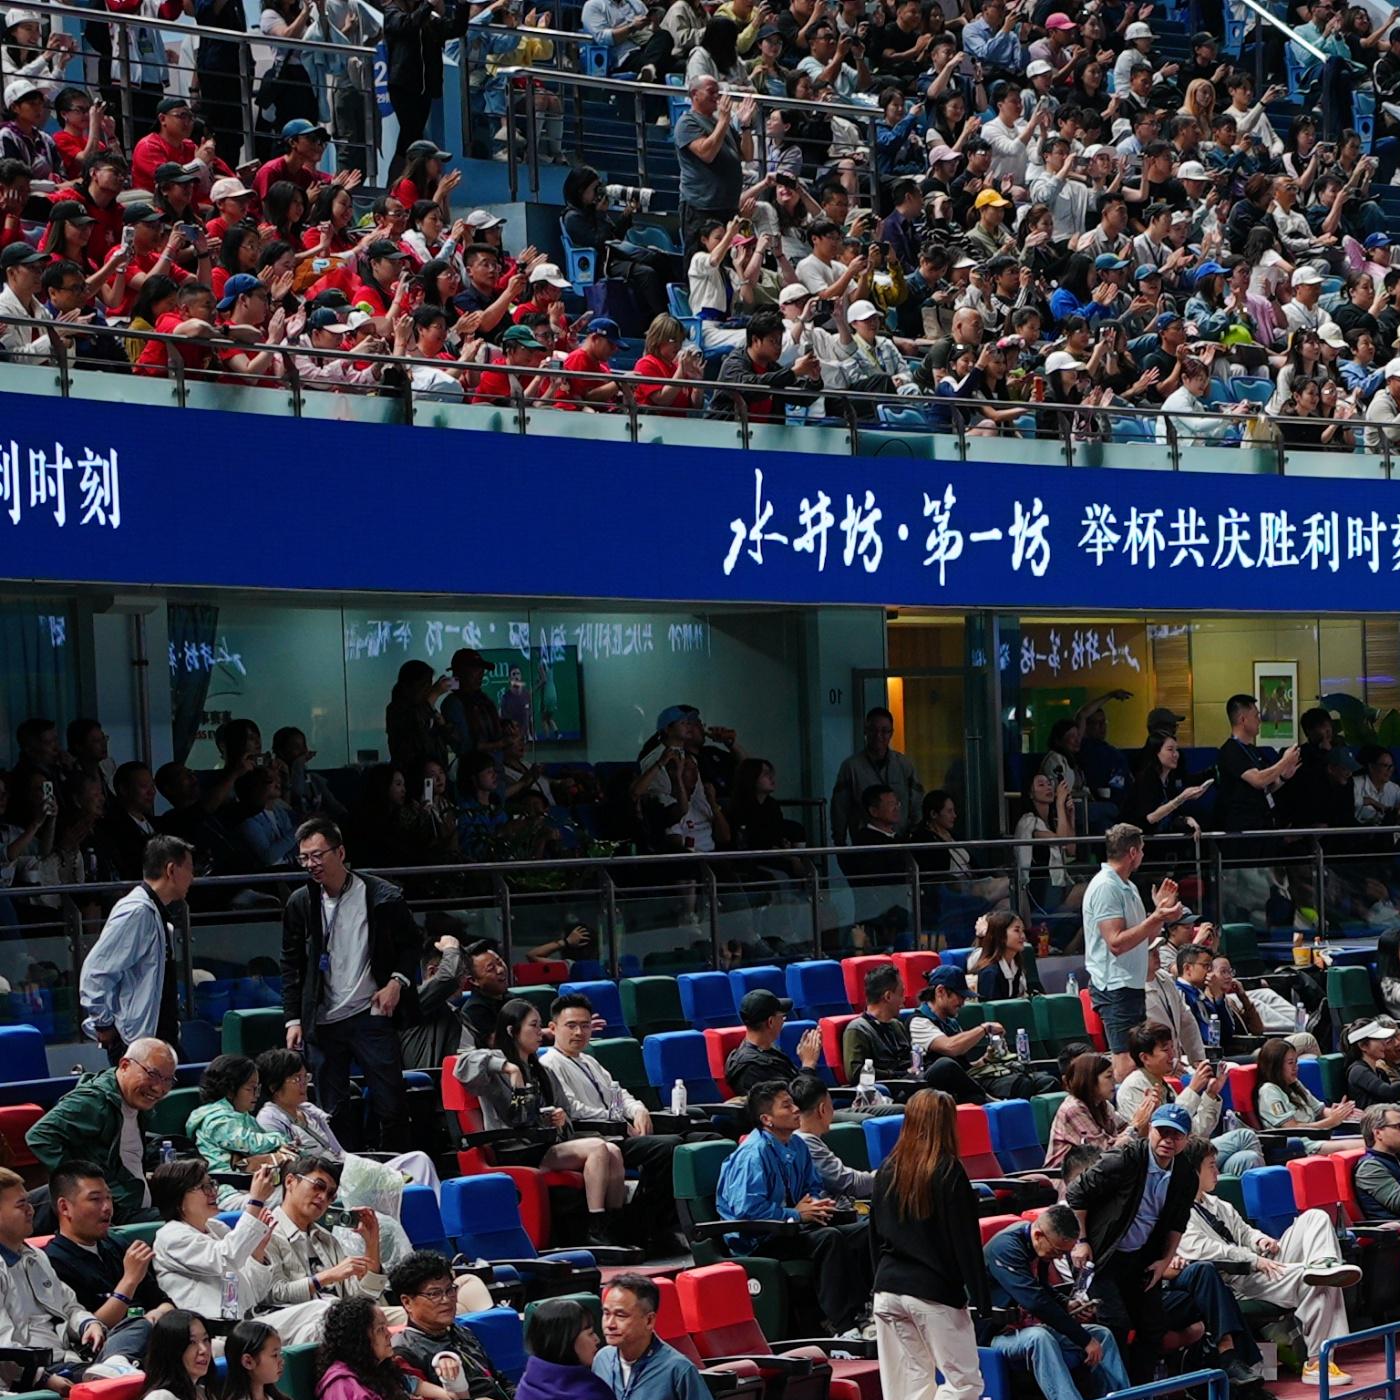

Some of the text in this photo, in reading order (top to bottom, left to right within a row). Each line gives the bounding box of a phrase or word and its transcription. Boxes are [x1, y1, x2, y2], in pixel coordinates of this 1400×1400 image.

[723, 467, 1052, 587] 水井坊·第一坊
